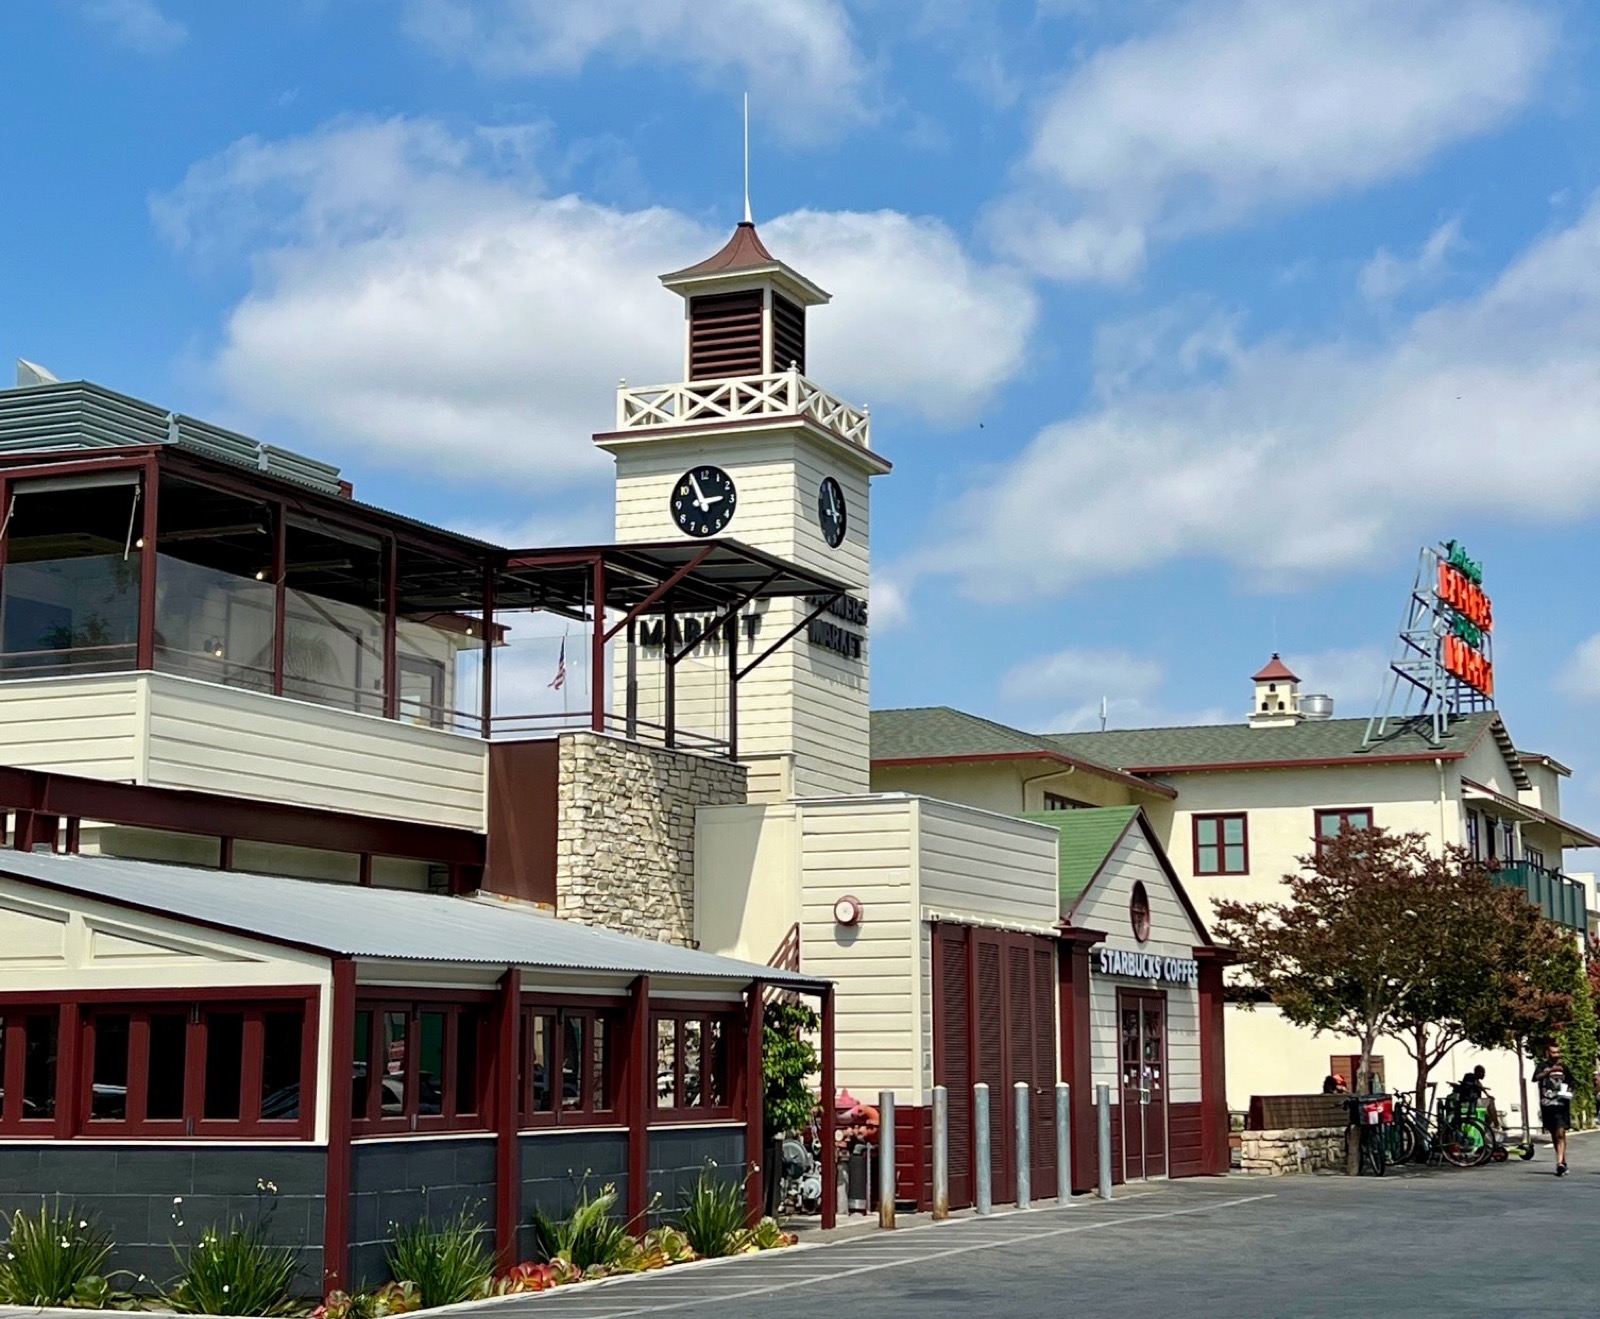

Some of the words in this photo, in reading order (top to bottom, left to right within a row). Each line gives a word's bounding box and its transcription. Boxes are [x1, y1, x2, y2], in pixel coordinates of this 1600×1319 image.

[700, 470, 710, 480] 12
[724, 480, 731, 490] 2
[680, 485, 690, 496] 10
[728, 493, 735, 503] 3
[675, 500, 682, 510] 9
[679, 513, 686, 524] 8
[723, 509, 730, 519] 4
[690, 521, 696, 532] 7
[715, 518, 721, 529] 5
[701, 525, 709, 534] 6
[1100, 948, 1161, 980] STARBUCKS
[1163, 957, 1199, 983] COFFEE
